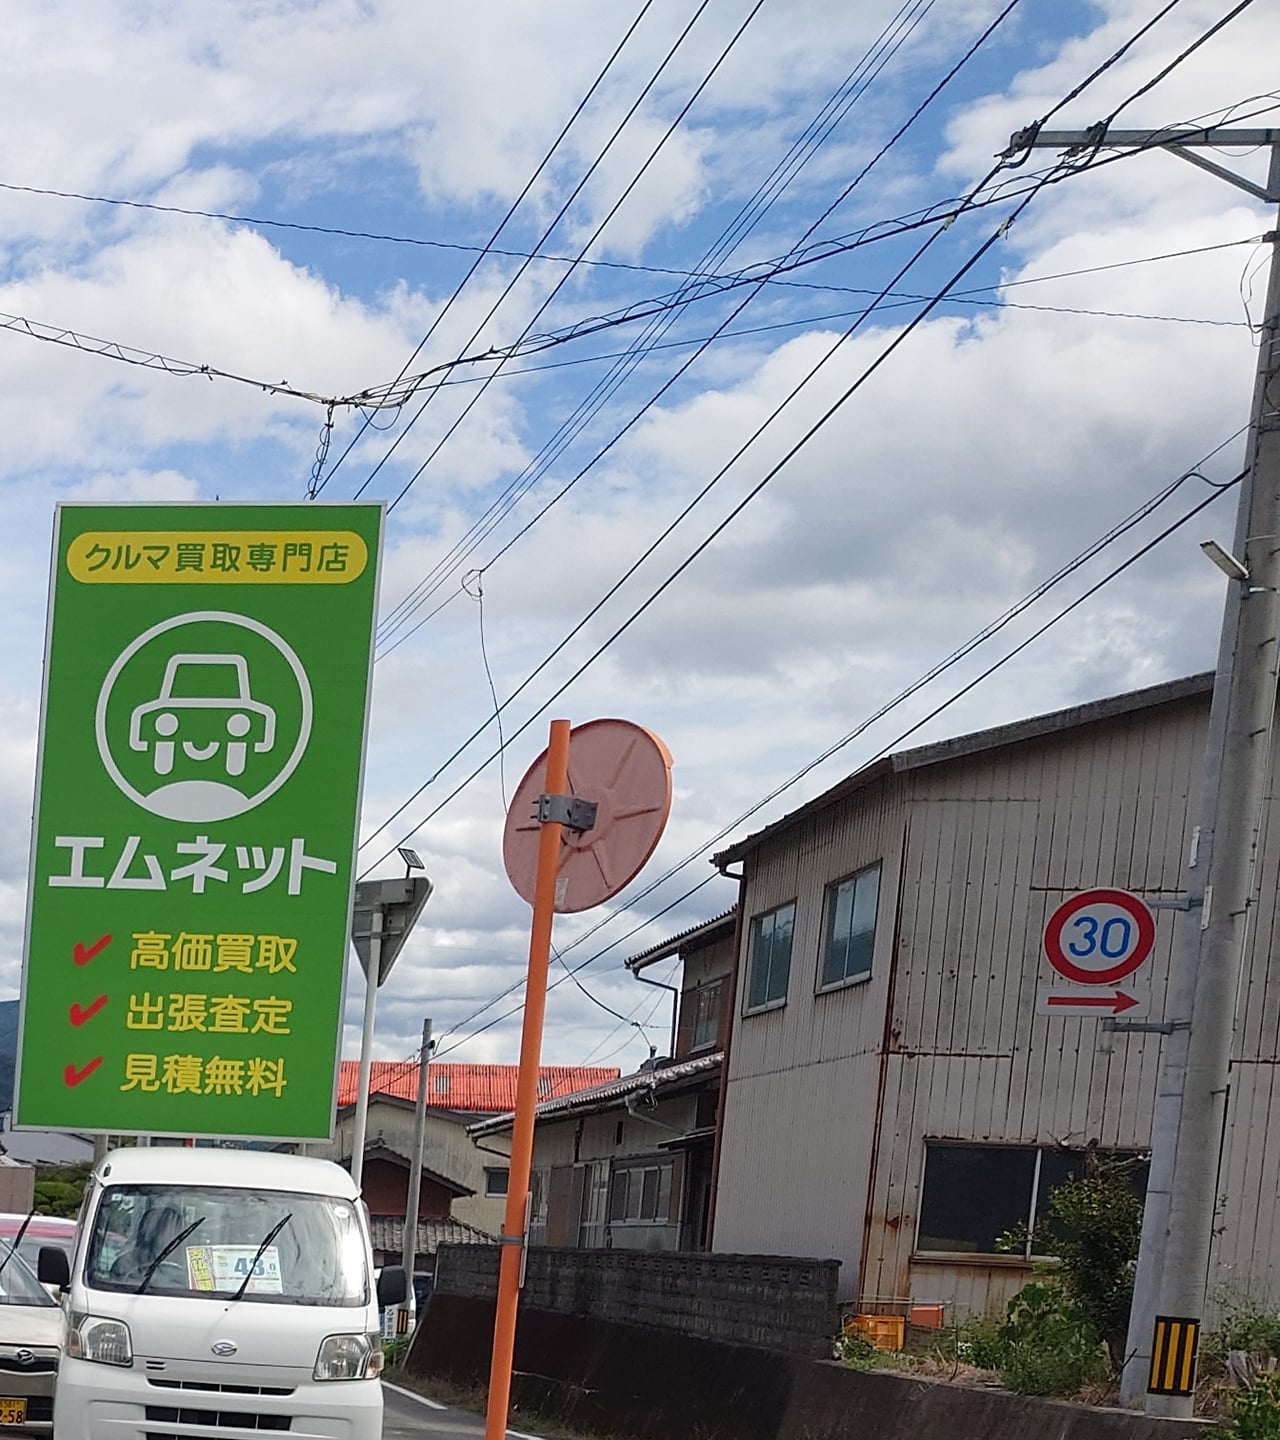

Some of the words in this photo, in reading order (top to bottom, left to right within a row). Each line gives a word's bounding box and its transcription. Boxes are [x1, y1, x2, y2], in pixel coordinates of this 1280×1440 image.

[84, 542, 350, 574] クルマ買取専門店
[48, 835, 338, 895] エムネット
[130, 931, 298, 974] 高価買取
[1068, 916, 1132, 958] 30
[125, 993, 293, 1035] 出張査定
[120, 1054, 287, 1098] 見積無料
